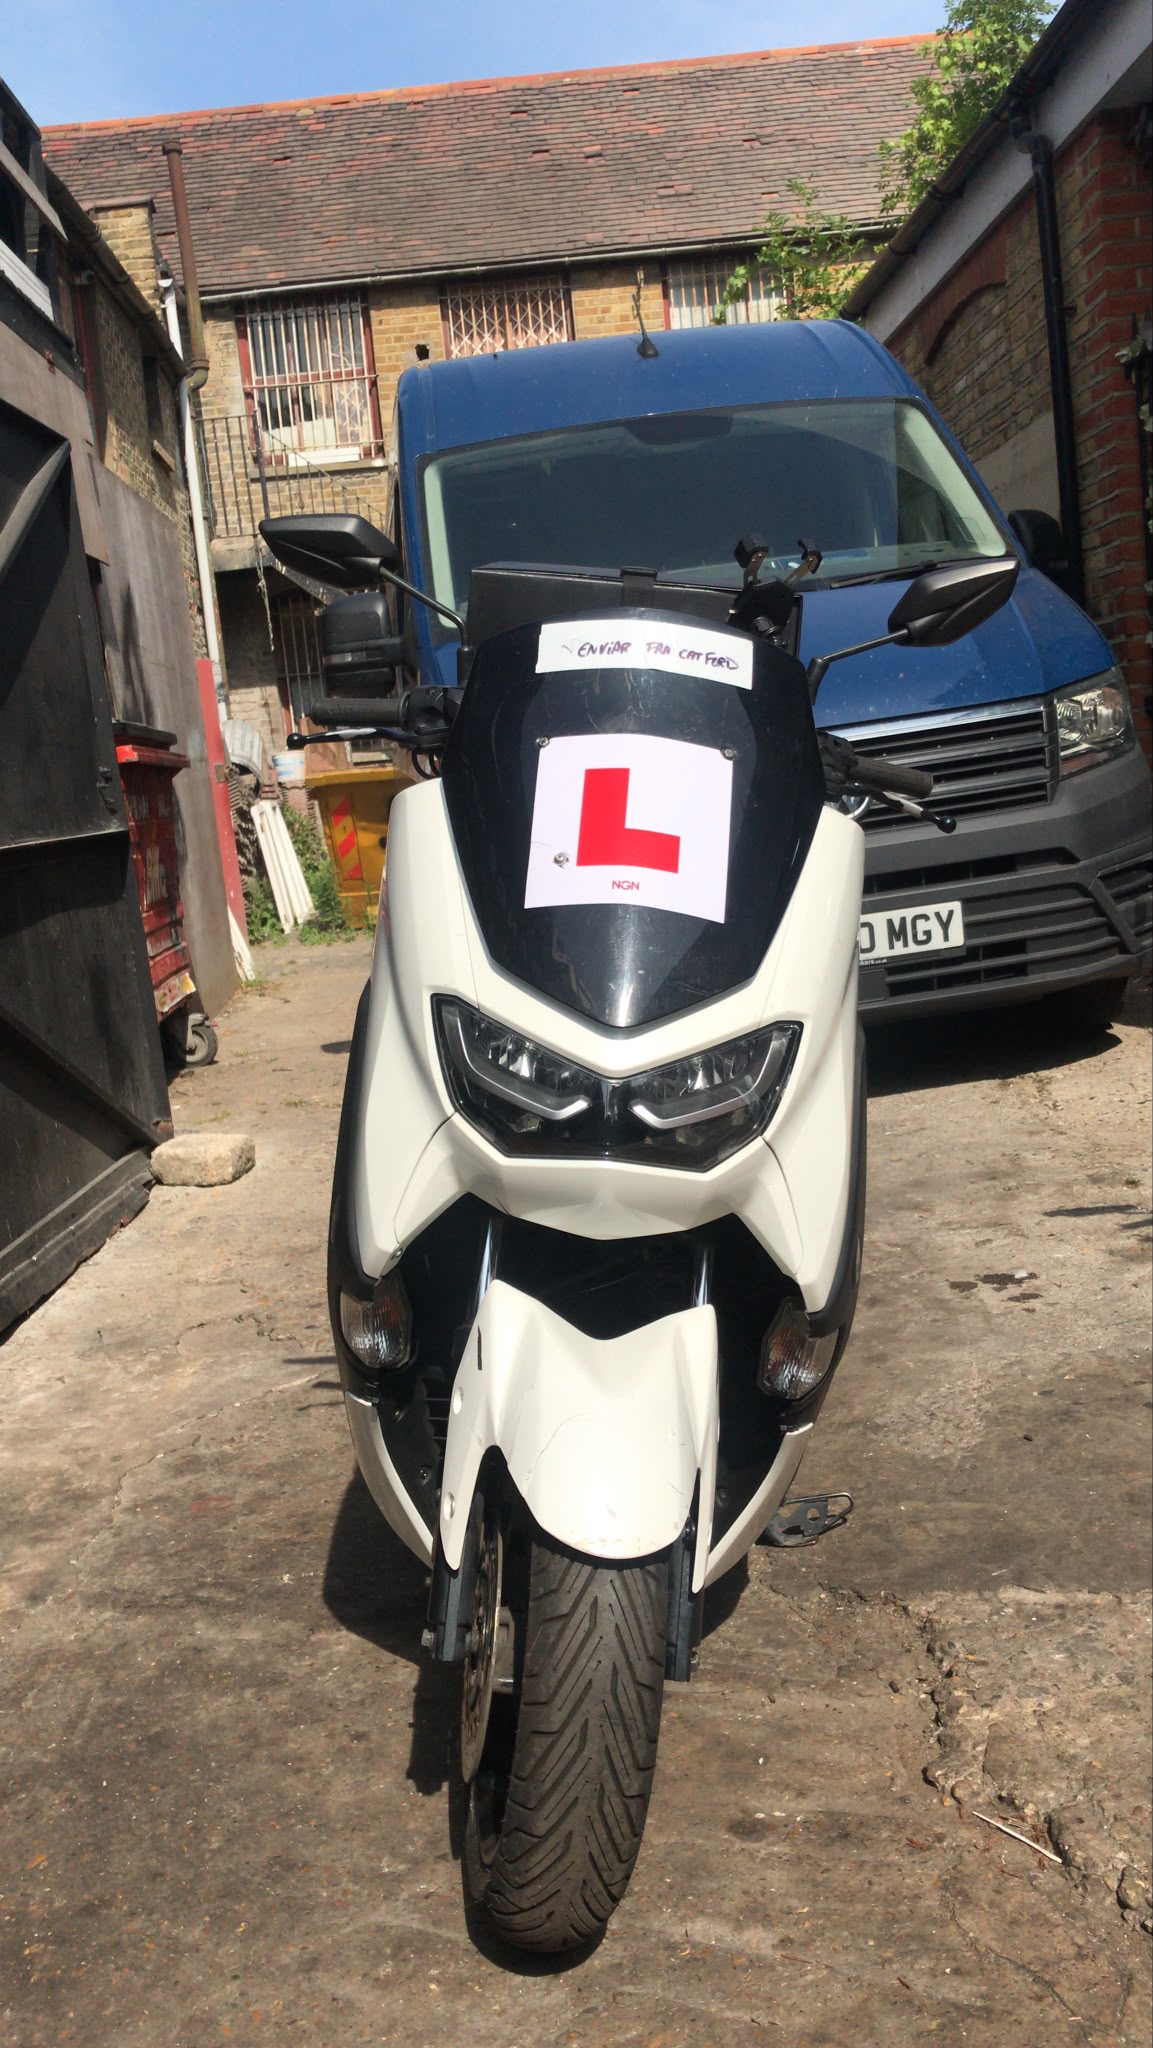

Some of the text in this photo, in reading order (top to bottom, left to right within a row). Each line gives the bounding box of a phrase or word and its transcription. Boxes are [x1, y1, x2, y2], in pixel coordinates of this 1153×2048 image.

[576, 767, 681, 874] L
[611, 879, 640, 891] NGN
[886, 909, 955, 951] MGY
